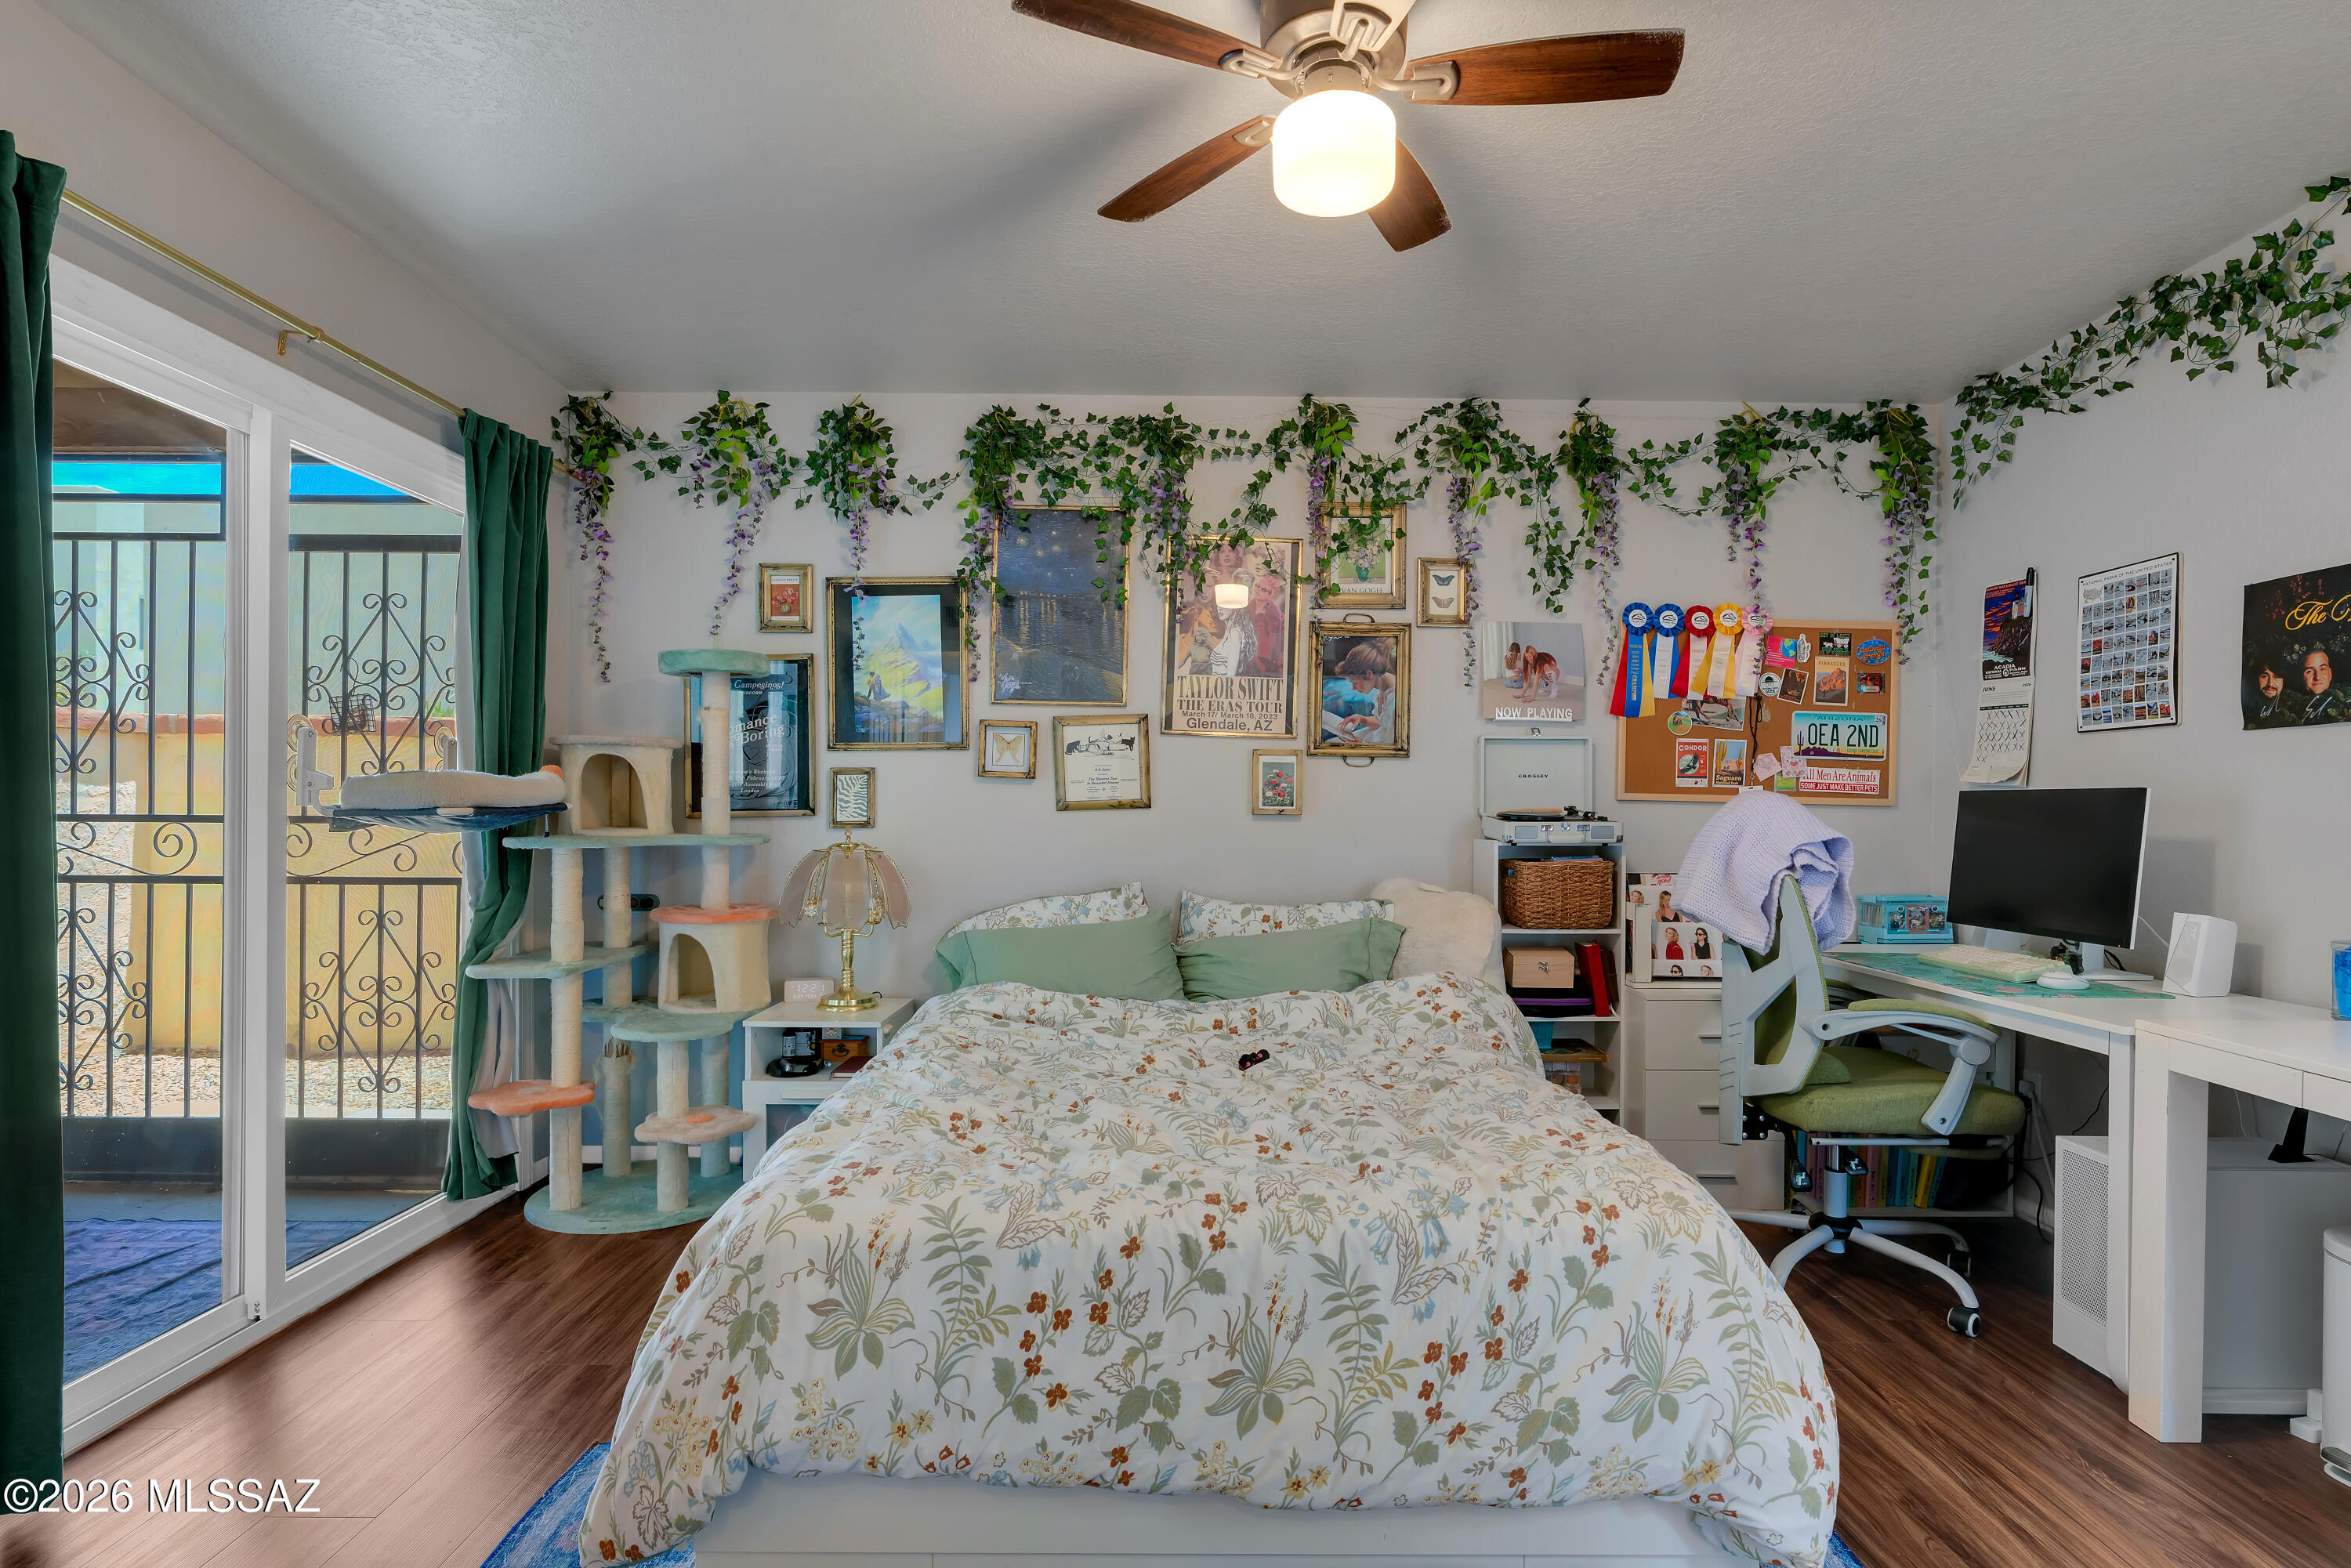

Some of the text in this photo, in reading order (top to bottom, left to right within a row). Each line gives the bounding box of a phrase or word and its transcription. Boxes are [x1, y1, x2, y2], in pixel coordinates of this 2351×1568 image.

[2285, 599, 2334, 631] The
[734, 680, 784, 690] Campesinos!
[1177, 675, 1284, 701] TAYLOR SWIFT
[1177, 699, 1282, 713] THE ERAS TOUR
[1495, 707, 1573, 719] NOW PLAYING
[729, 715, 778, 733] omance
[1186, 718, 1273, 732] Glendale, AZ
[734, 724, 784, 744] Boring
[1808, 722, 1879, 748] OEA 2ND
[1817, 770, 1831, 780] Men
[1832, 770, 1846, 781] Are
[1846, 771, 1876, 782] Animals
